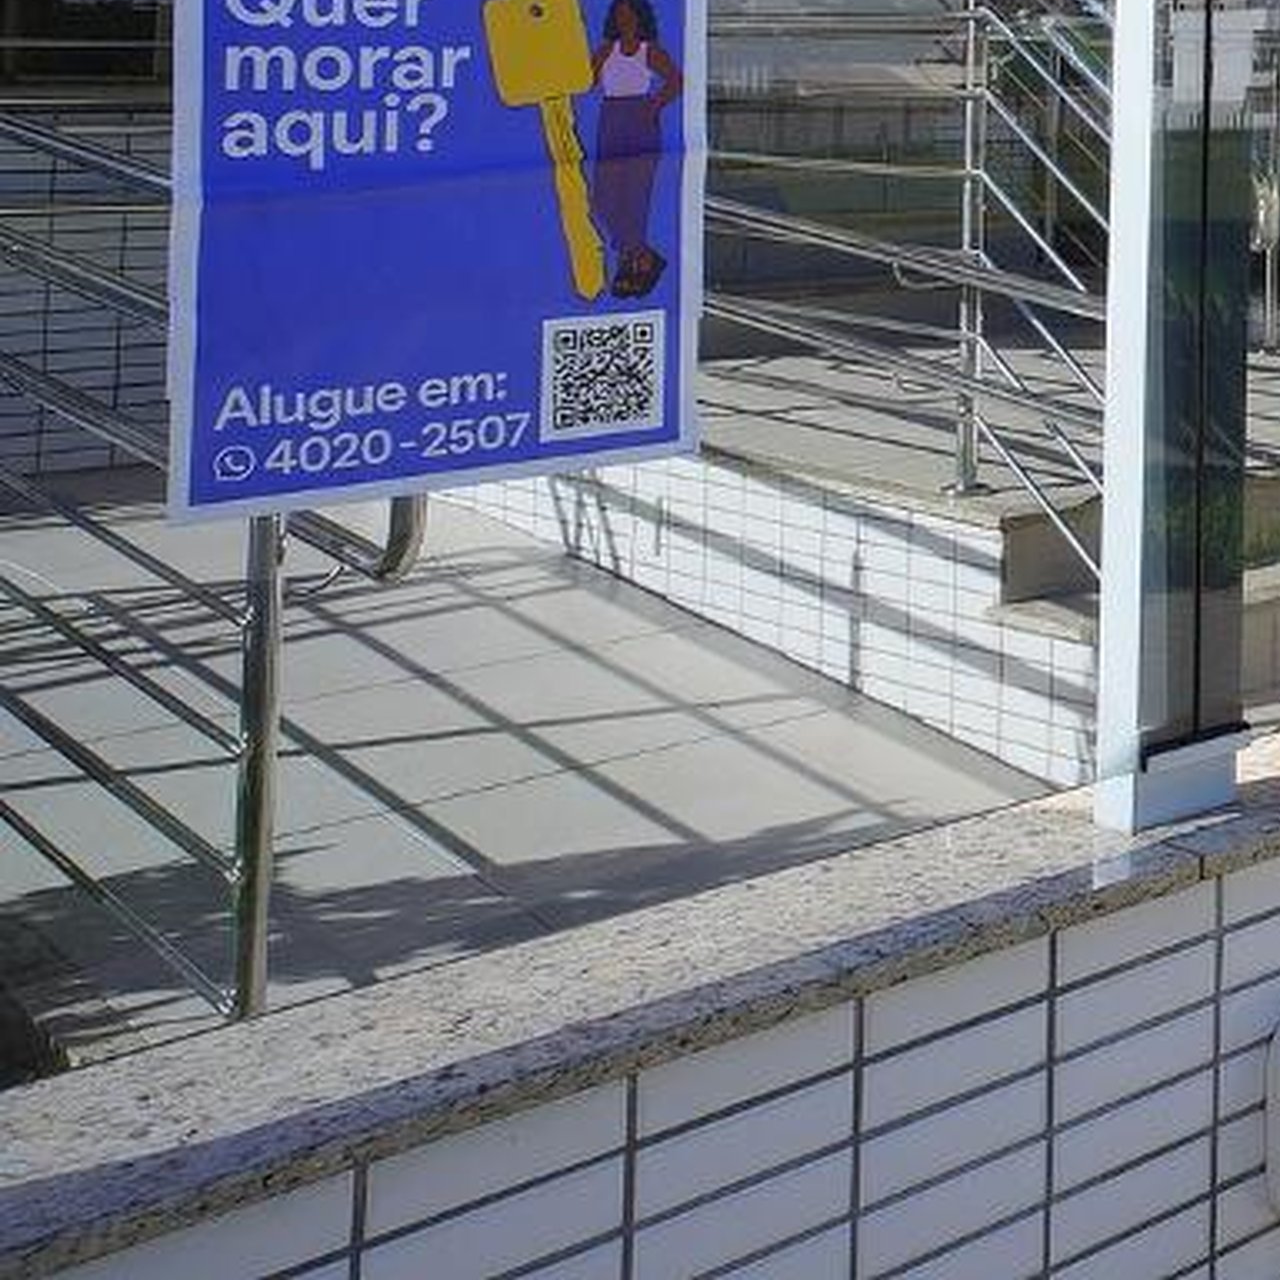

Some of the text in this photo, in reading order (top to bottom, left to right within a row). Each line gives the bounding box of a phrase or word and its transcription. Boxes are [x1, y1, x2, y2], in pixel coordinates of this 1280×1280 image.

[225, 40, 470, 91] morar
[222, 93, 449, 168] aqui?
[213, 370, 506, 431] Alugue em:
